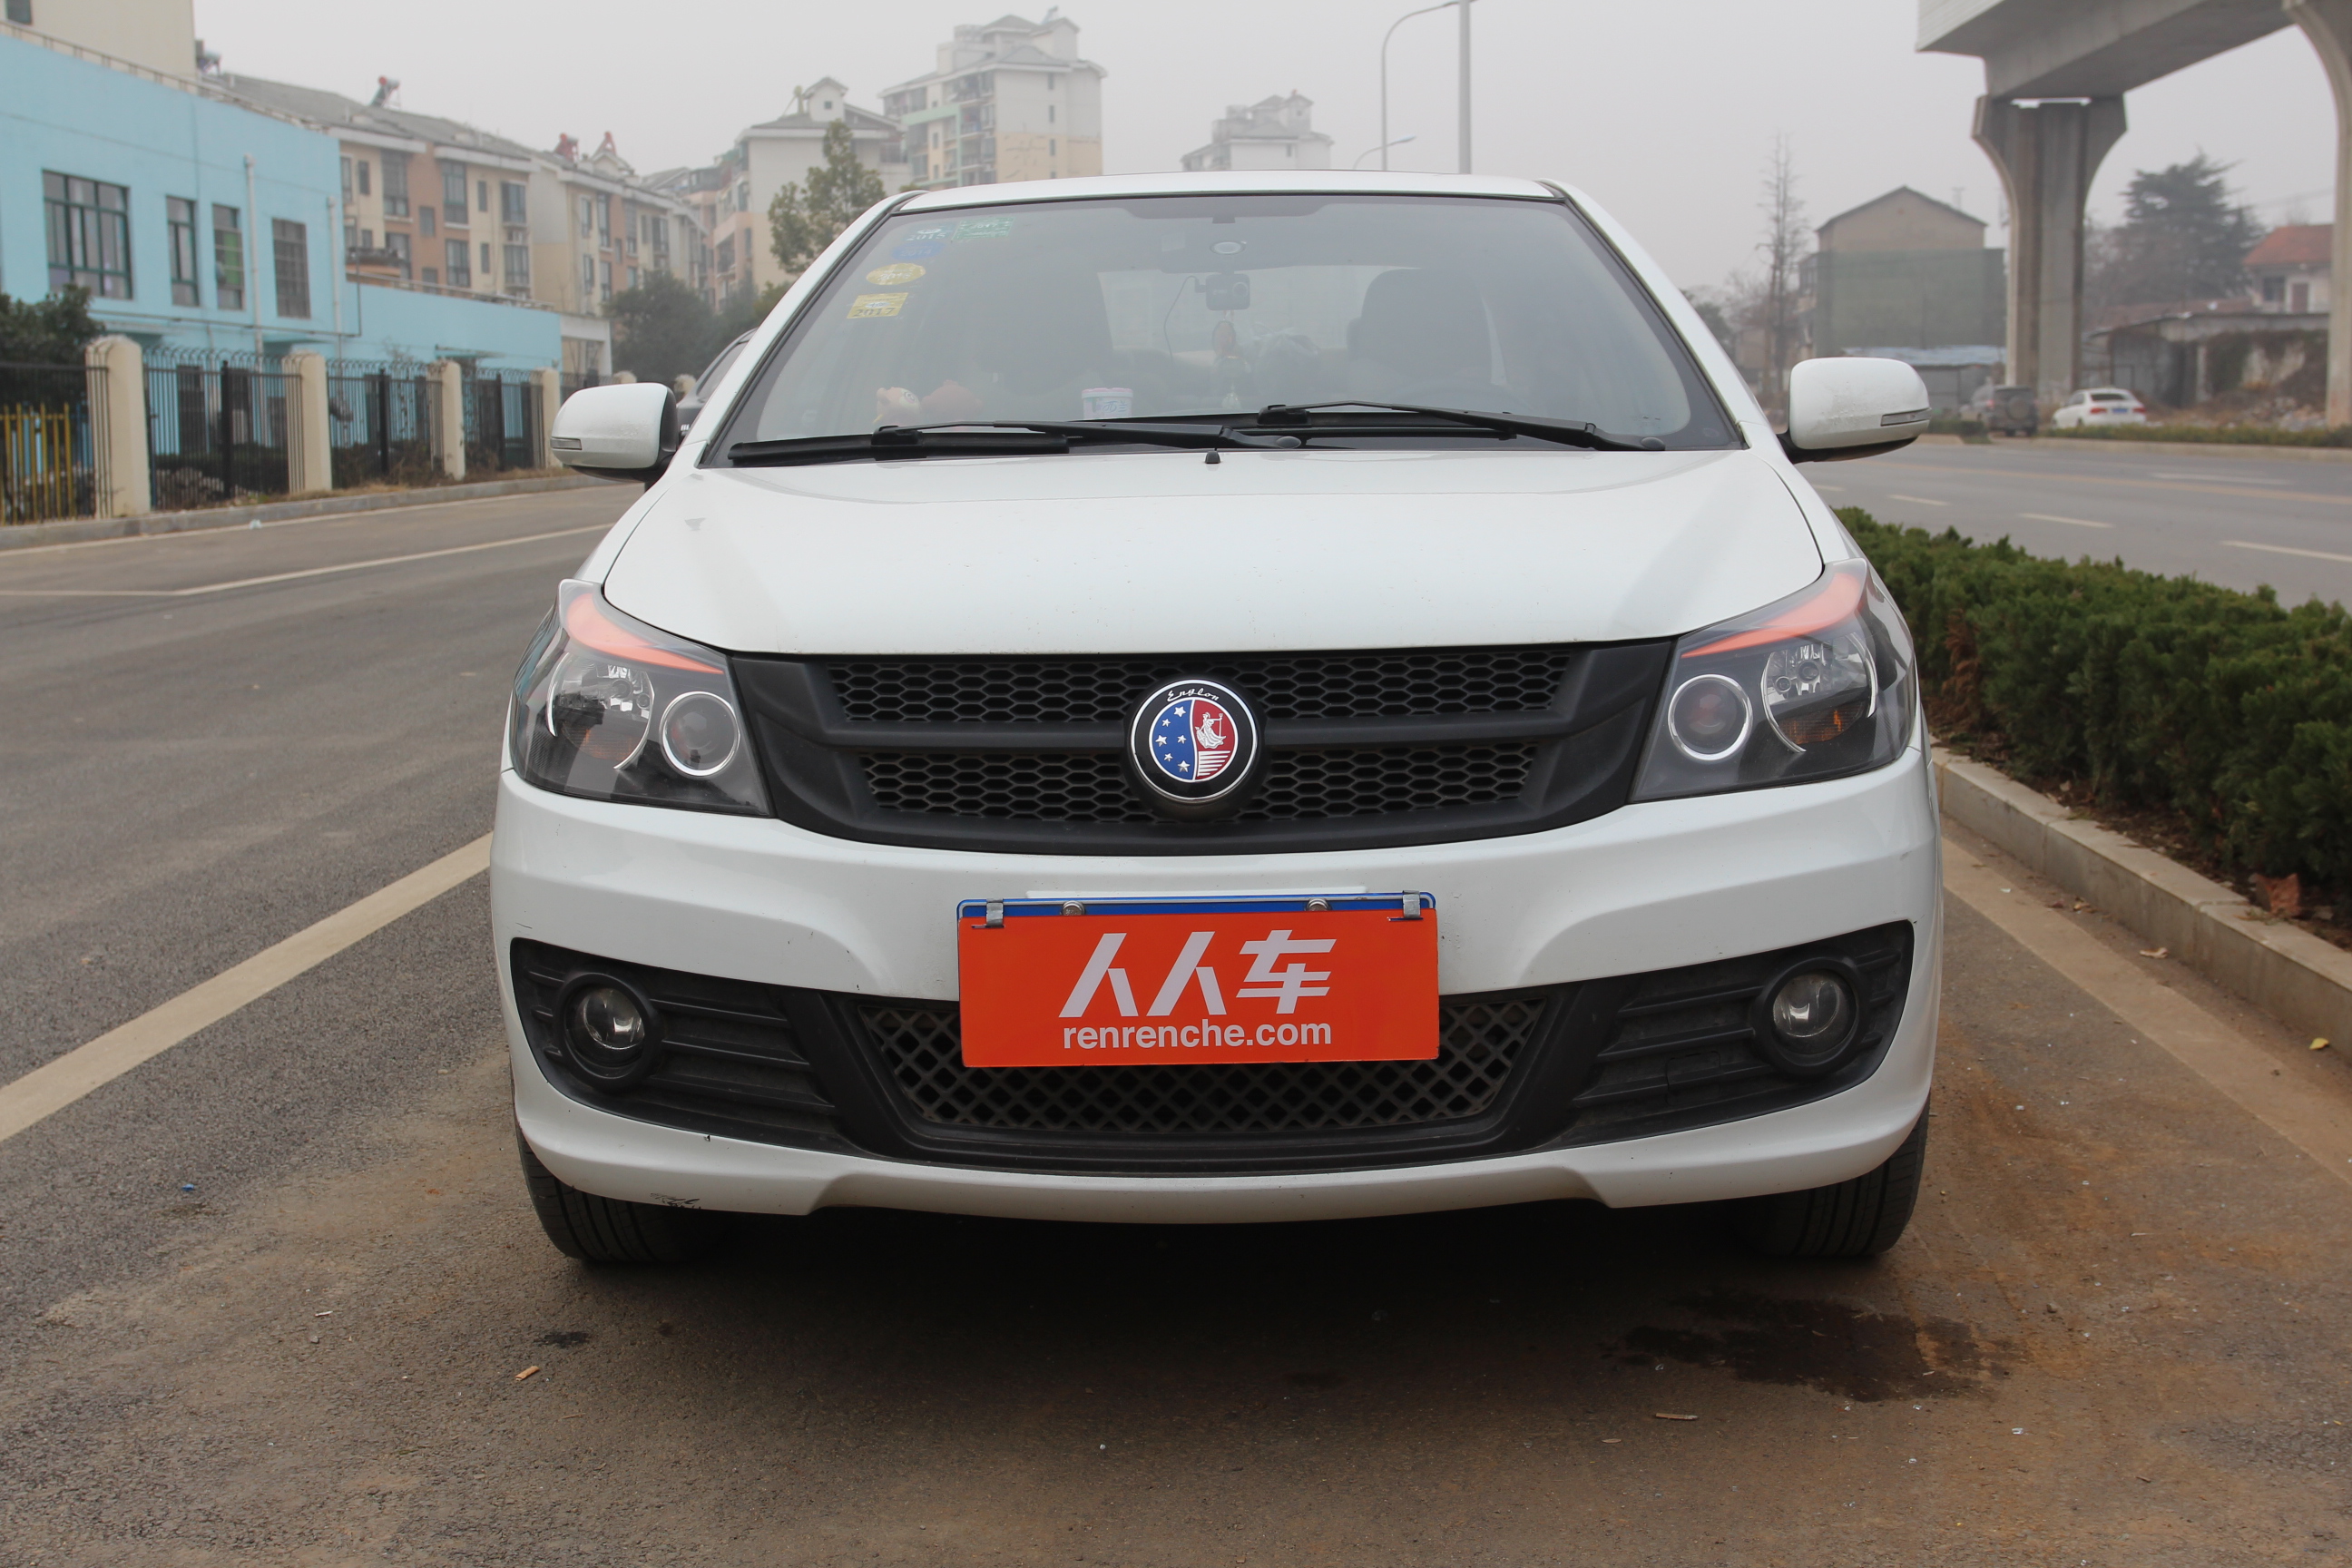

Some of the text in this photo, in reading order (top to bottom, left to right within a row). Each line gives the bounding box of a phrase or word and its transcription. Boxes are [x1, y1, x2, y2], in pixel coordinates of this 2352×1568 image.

[906, 232, 946, 241] 2015
[852, 307, 897, 318] 2017
[1166, 688, 1220, 703] Englon
[1058, 929, 1338, 1018] 人人车
[1063, 1018, 1332, 1049] renrenche.com
